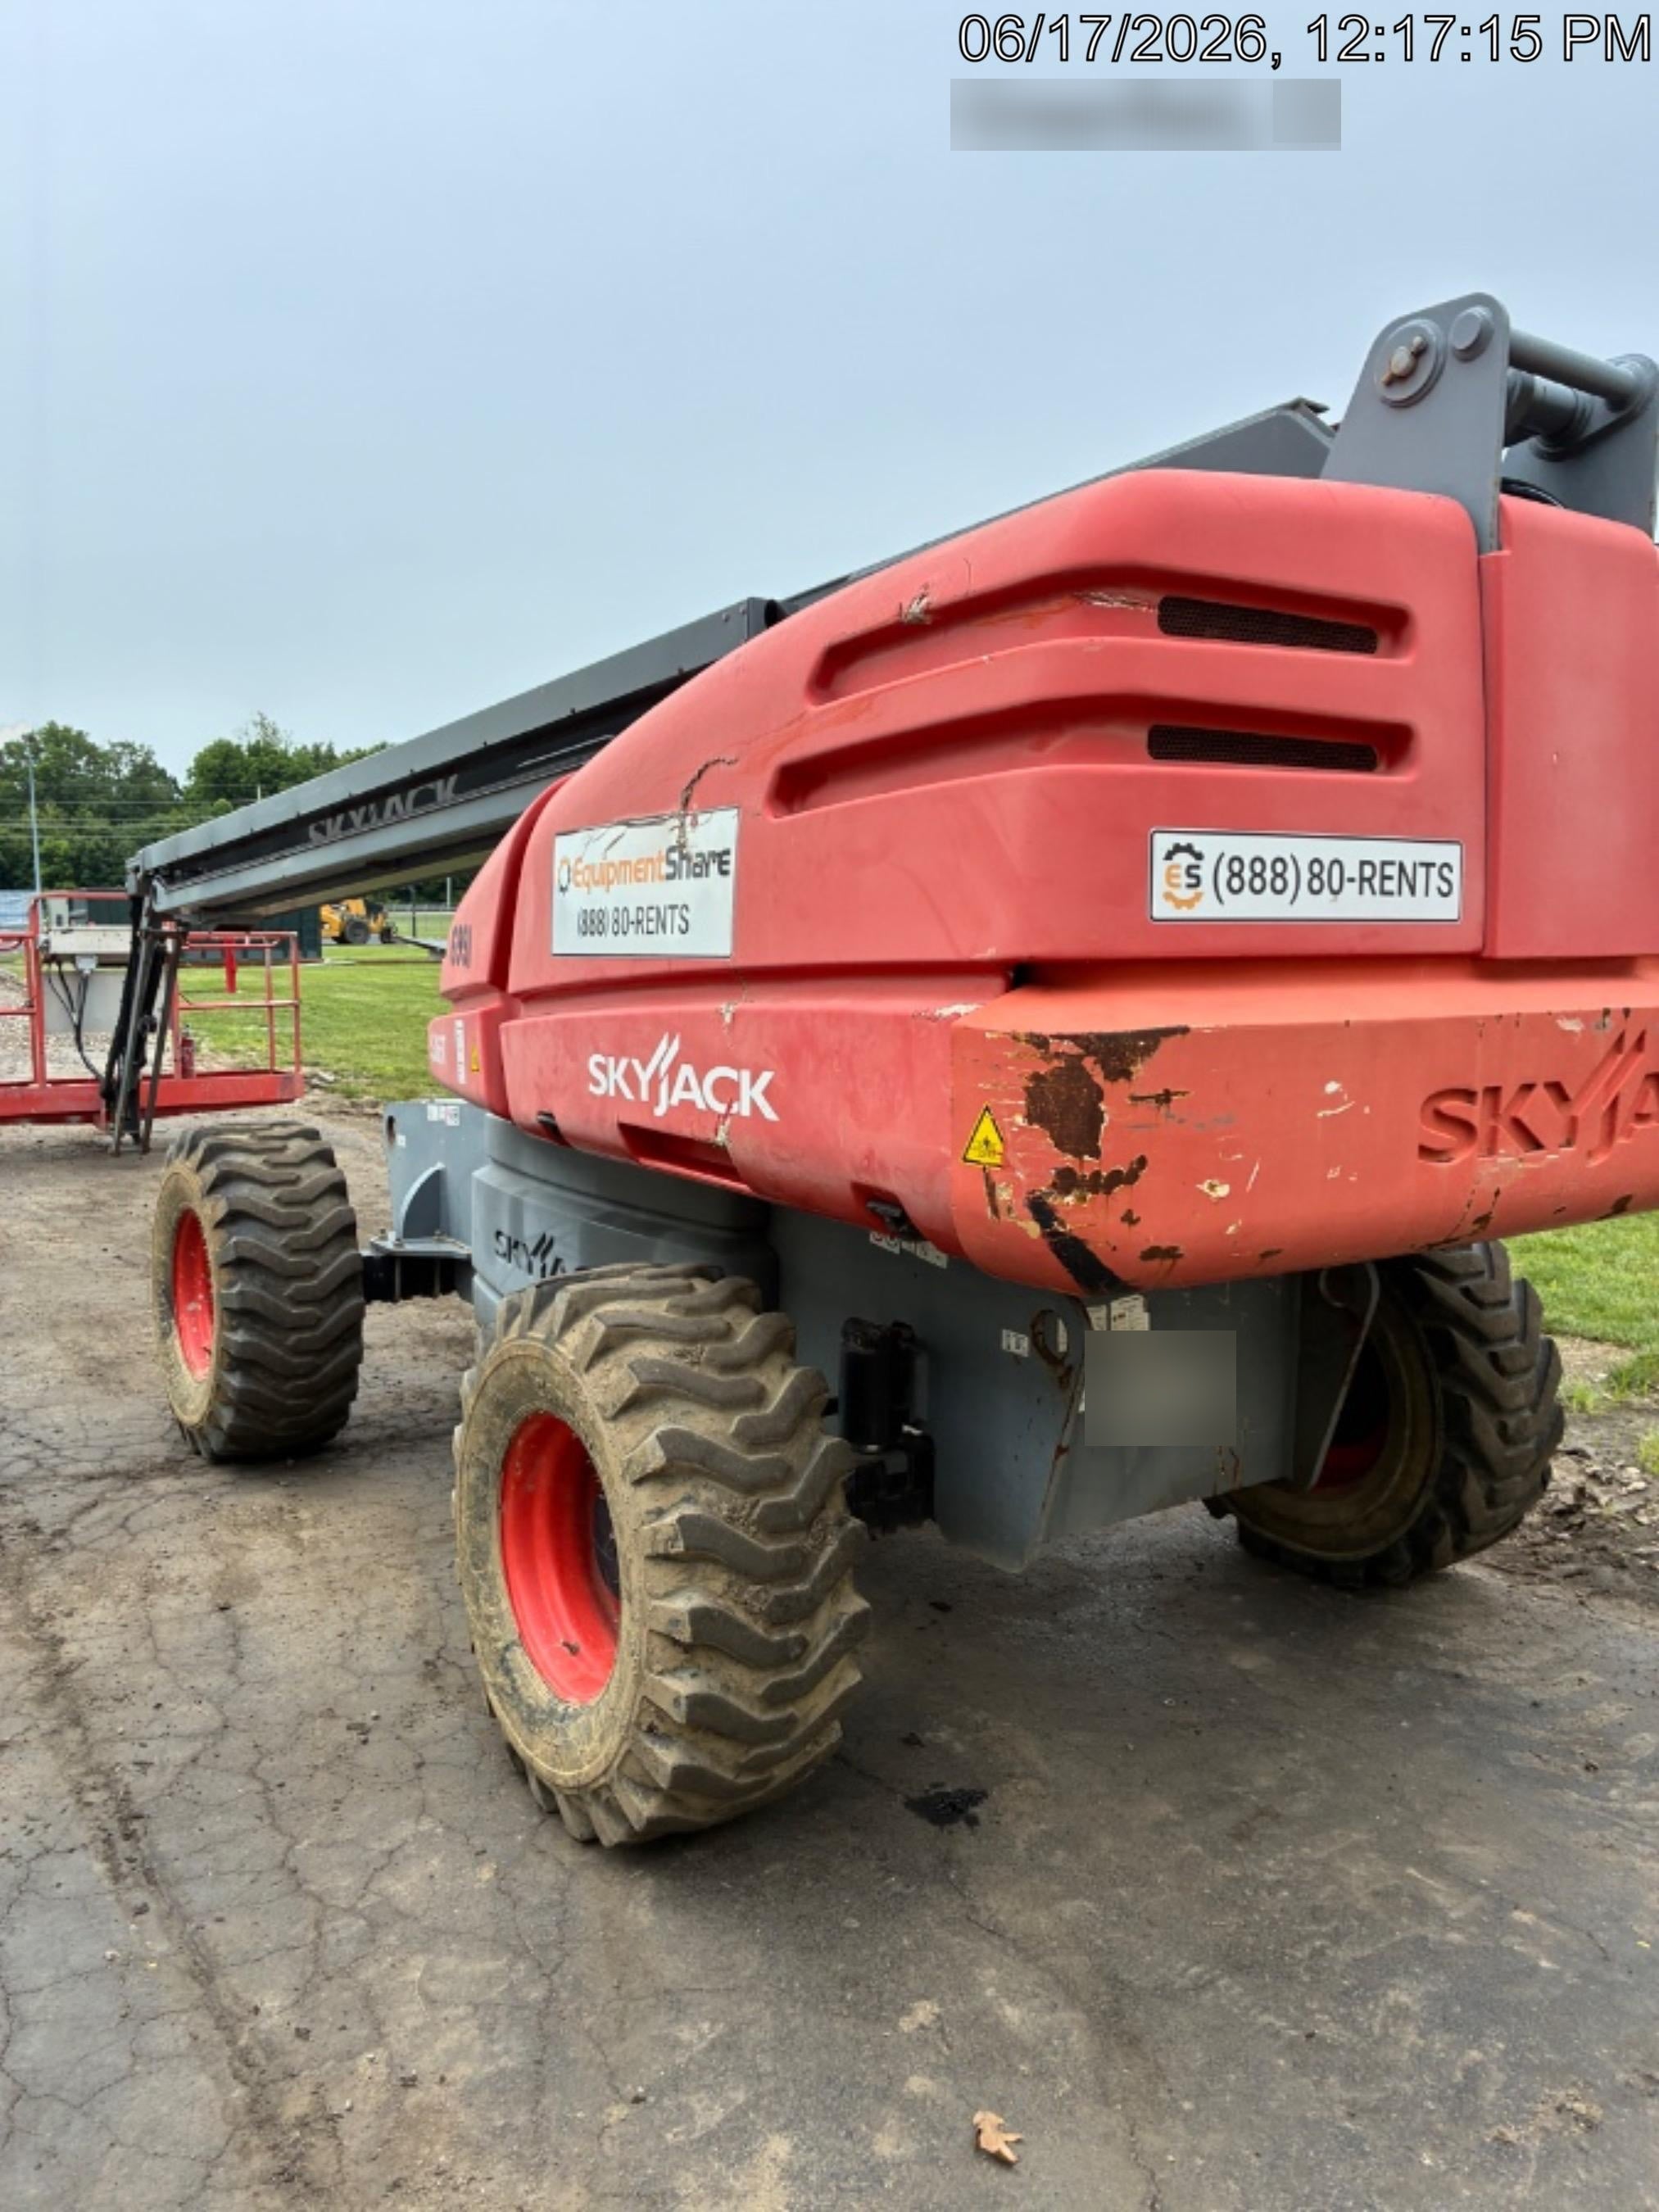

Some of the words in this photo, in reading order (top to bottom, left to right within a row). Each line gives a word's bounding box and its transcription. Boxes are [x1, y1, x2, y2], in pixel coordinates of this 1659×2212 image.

[573, 845, 732, 895] EquipmentShare
[1213, 852, 1301, 905] (888)
[1308, 857, 1455, 899] 80-RENTS
[611, 904, 690, 936] 80-RENTS
[588, 1031, 780, 1122] SKYJACK
